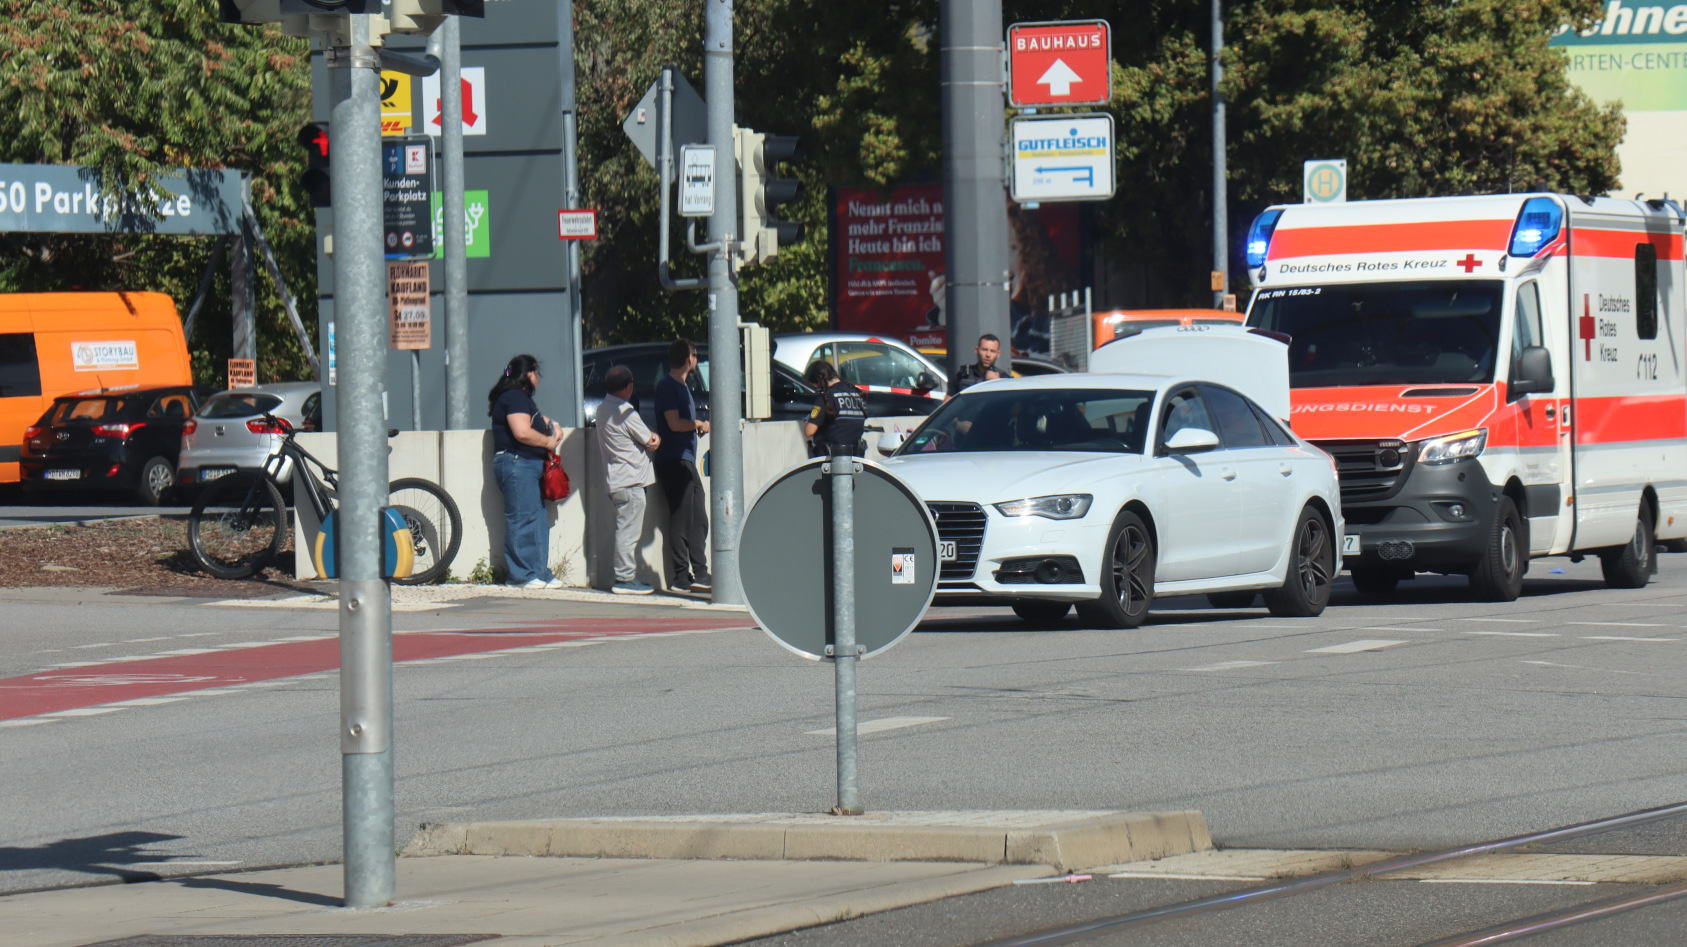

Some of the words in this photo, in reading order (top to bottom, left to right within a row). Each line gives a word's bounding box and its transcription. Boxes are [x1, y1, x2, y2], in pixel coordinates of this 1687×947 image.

[1017, 34, 1101, 51] BAUHAUS
[1018, 129, 1106, 151] GUTFLEISCH
[384, 177, 420, 189] Kunden-
[1318, 173, 1333, 194] H
[384, 190, 427, 204] Parkplatz
[694, 193, 711, 207] Vorrang
[848, 200, 891, 217] Nennt
[894, 198, 930, 215] mich
[848, 218, 886, 236] mehr
[848, 238, 890, 254] Heute
[892, 236, 916, 253] bin
[919, 235, 941, 252] ich
[1280, 263, 1352, 273] Deutsches
[1357, 260, 1398, 271] Rotes
[1404, 260, 1447, 269] Kreuz
[391, 282, 427, 295] KAUFLAND
[1599, 293, 1630, 313] Deutsches
[1600, 318, 1617, 337] Rotes
[94, 346, 134, 358] STORYBAU
[1600, 343, 1618, 362] Kreuz
[1644, 353, 1657, 380] 112
[940, 543, 954, 557] 20
